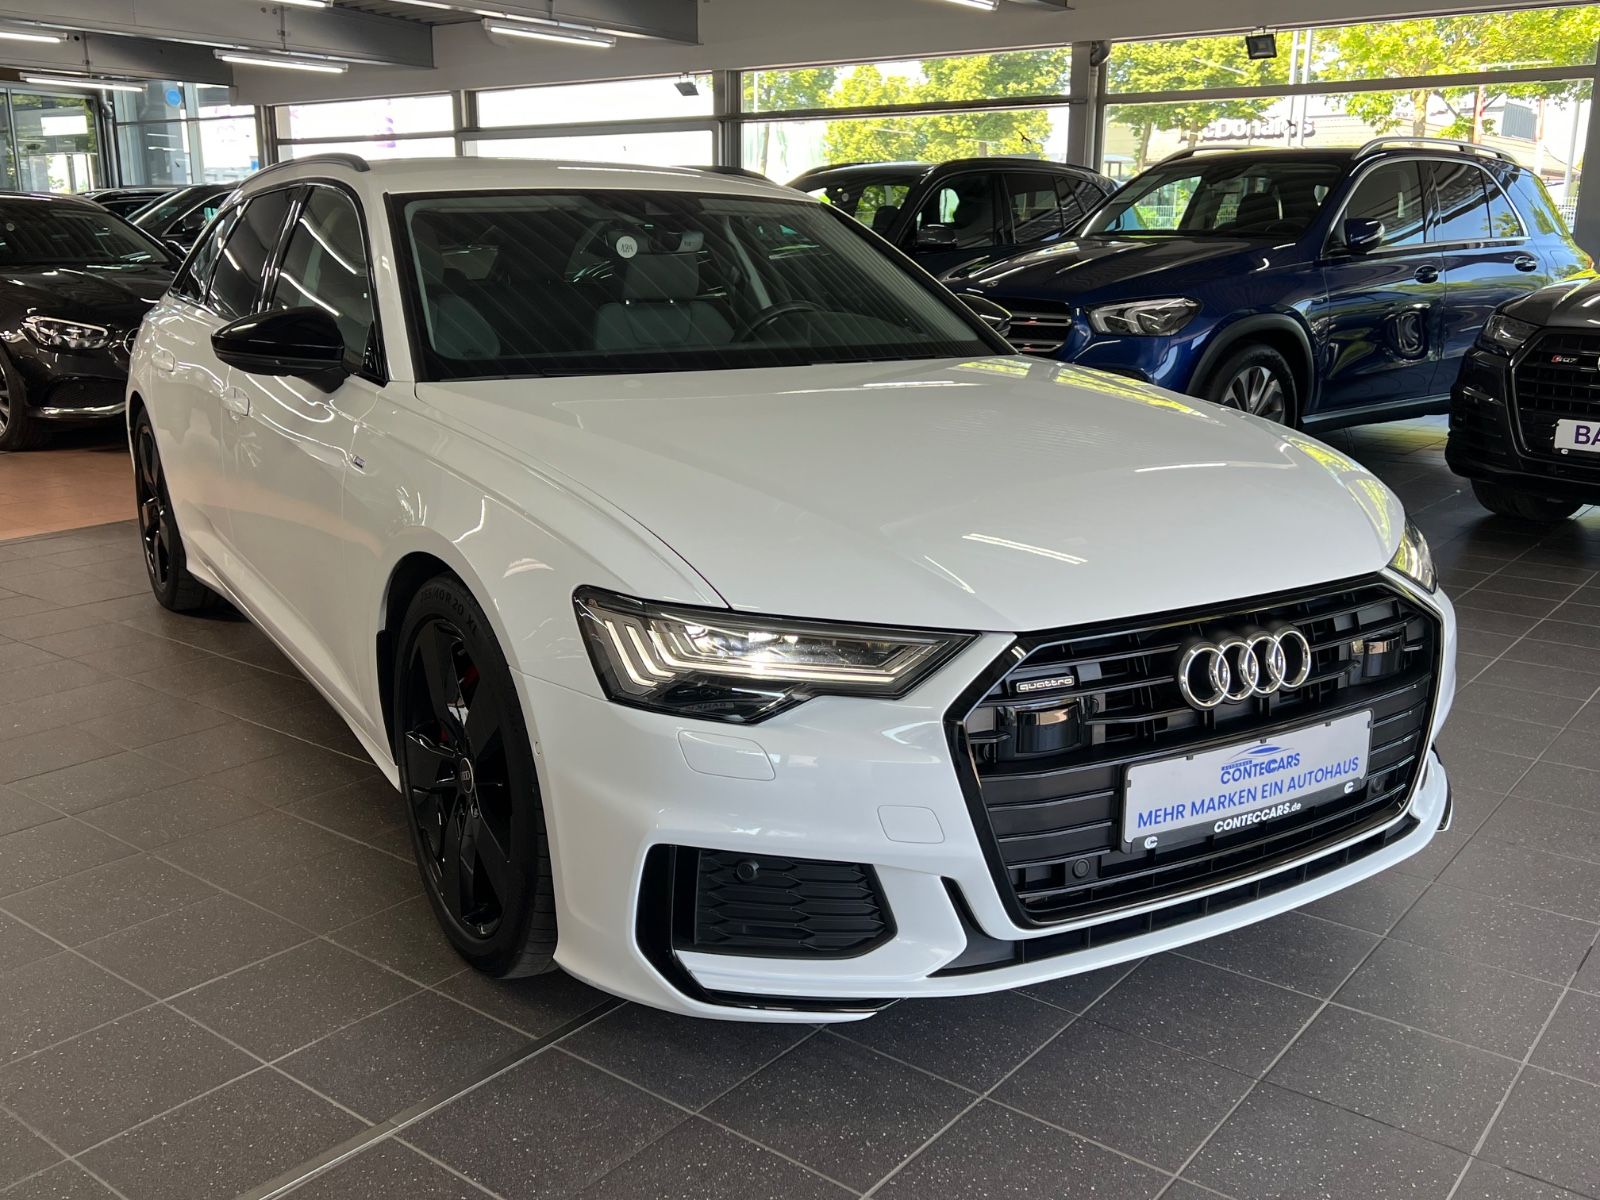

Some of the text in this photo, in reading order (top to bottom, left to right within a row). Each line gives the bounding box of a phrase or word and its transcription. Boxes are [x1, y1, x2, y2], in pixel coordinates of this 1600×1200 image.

[1019, 678, 1073, 691] quattro
[1137, 756, 1360, 828] MEHR MARKEN EIN AUTOHAUS
[1213, 802, 1302, 833] CONTECCARS.de
